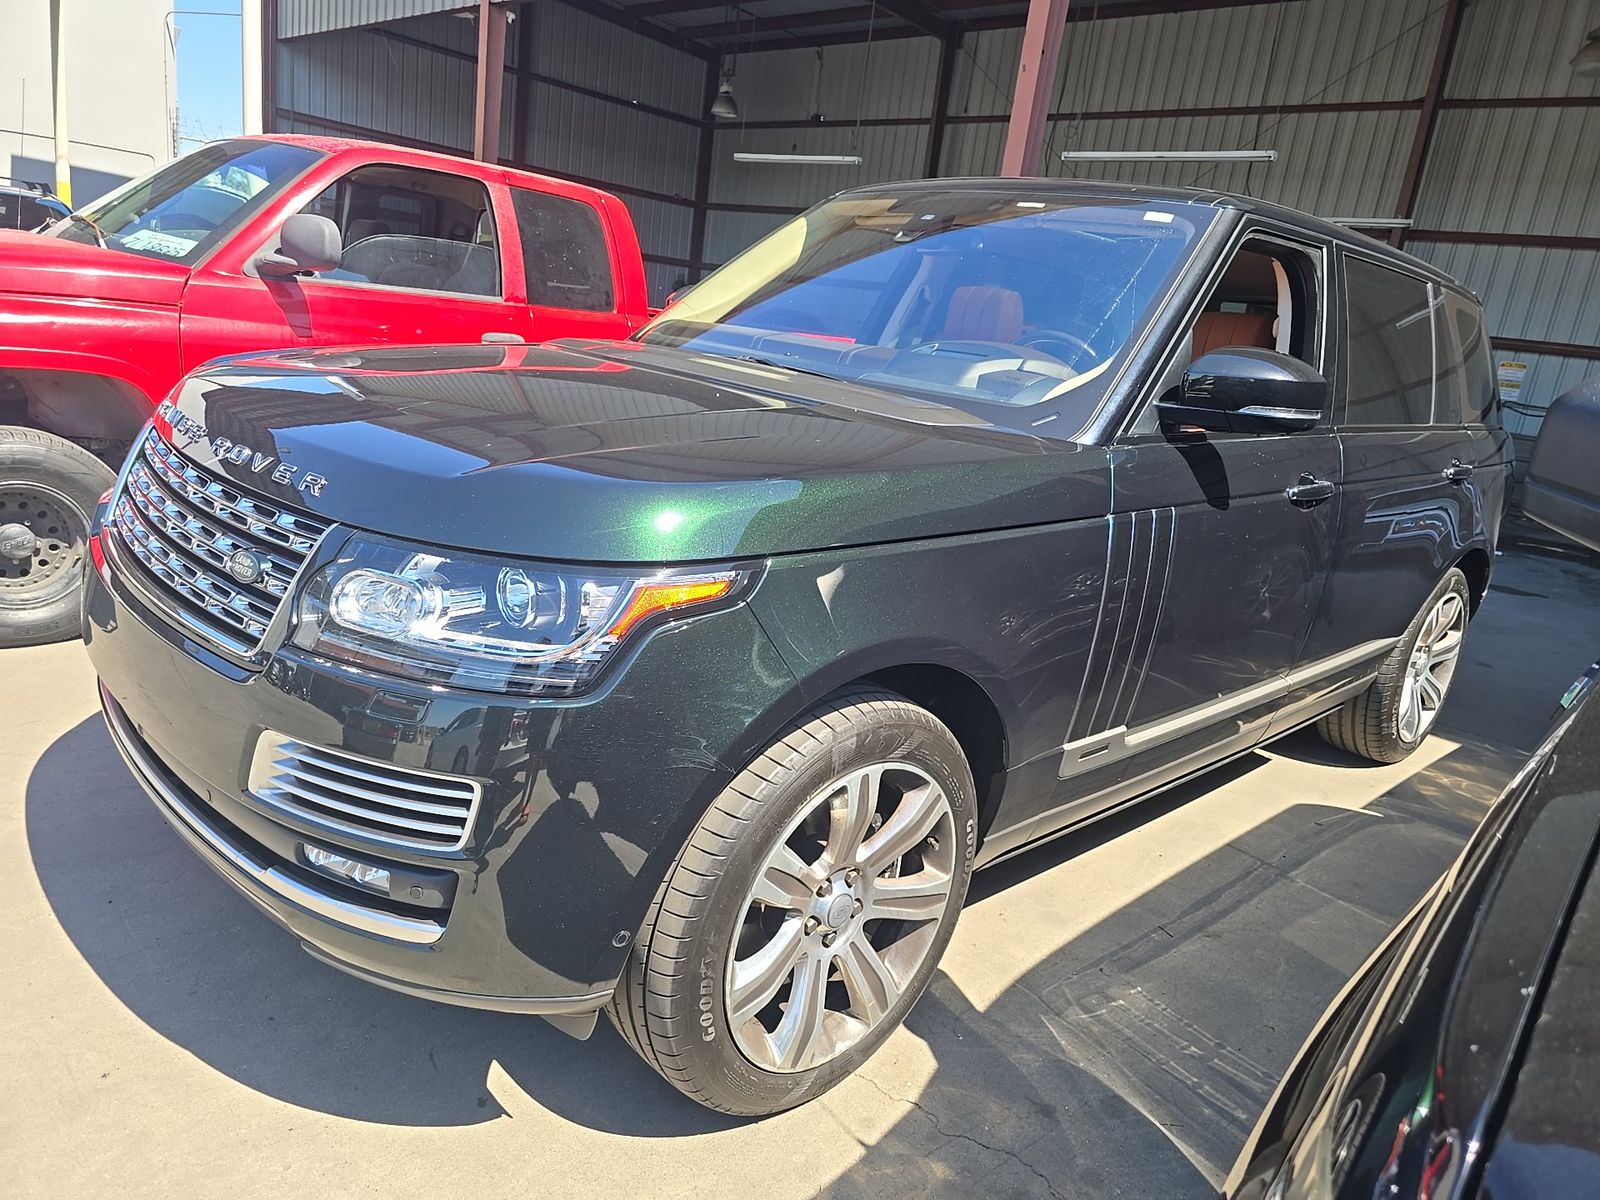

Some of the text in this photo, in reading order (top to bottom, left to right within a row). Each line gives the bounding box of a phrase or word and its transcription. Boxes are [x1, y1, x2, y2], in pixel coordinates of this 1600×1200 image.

[210, 436, 328, 497] ROVER
[235, 554, 252, 567] LAND
[234, 565, 253, 578] ROVER
